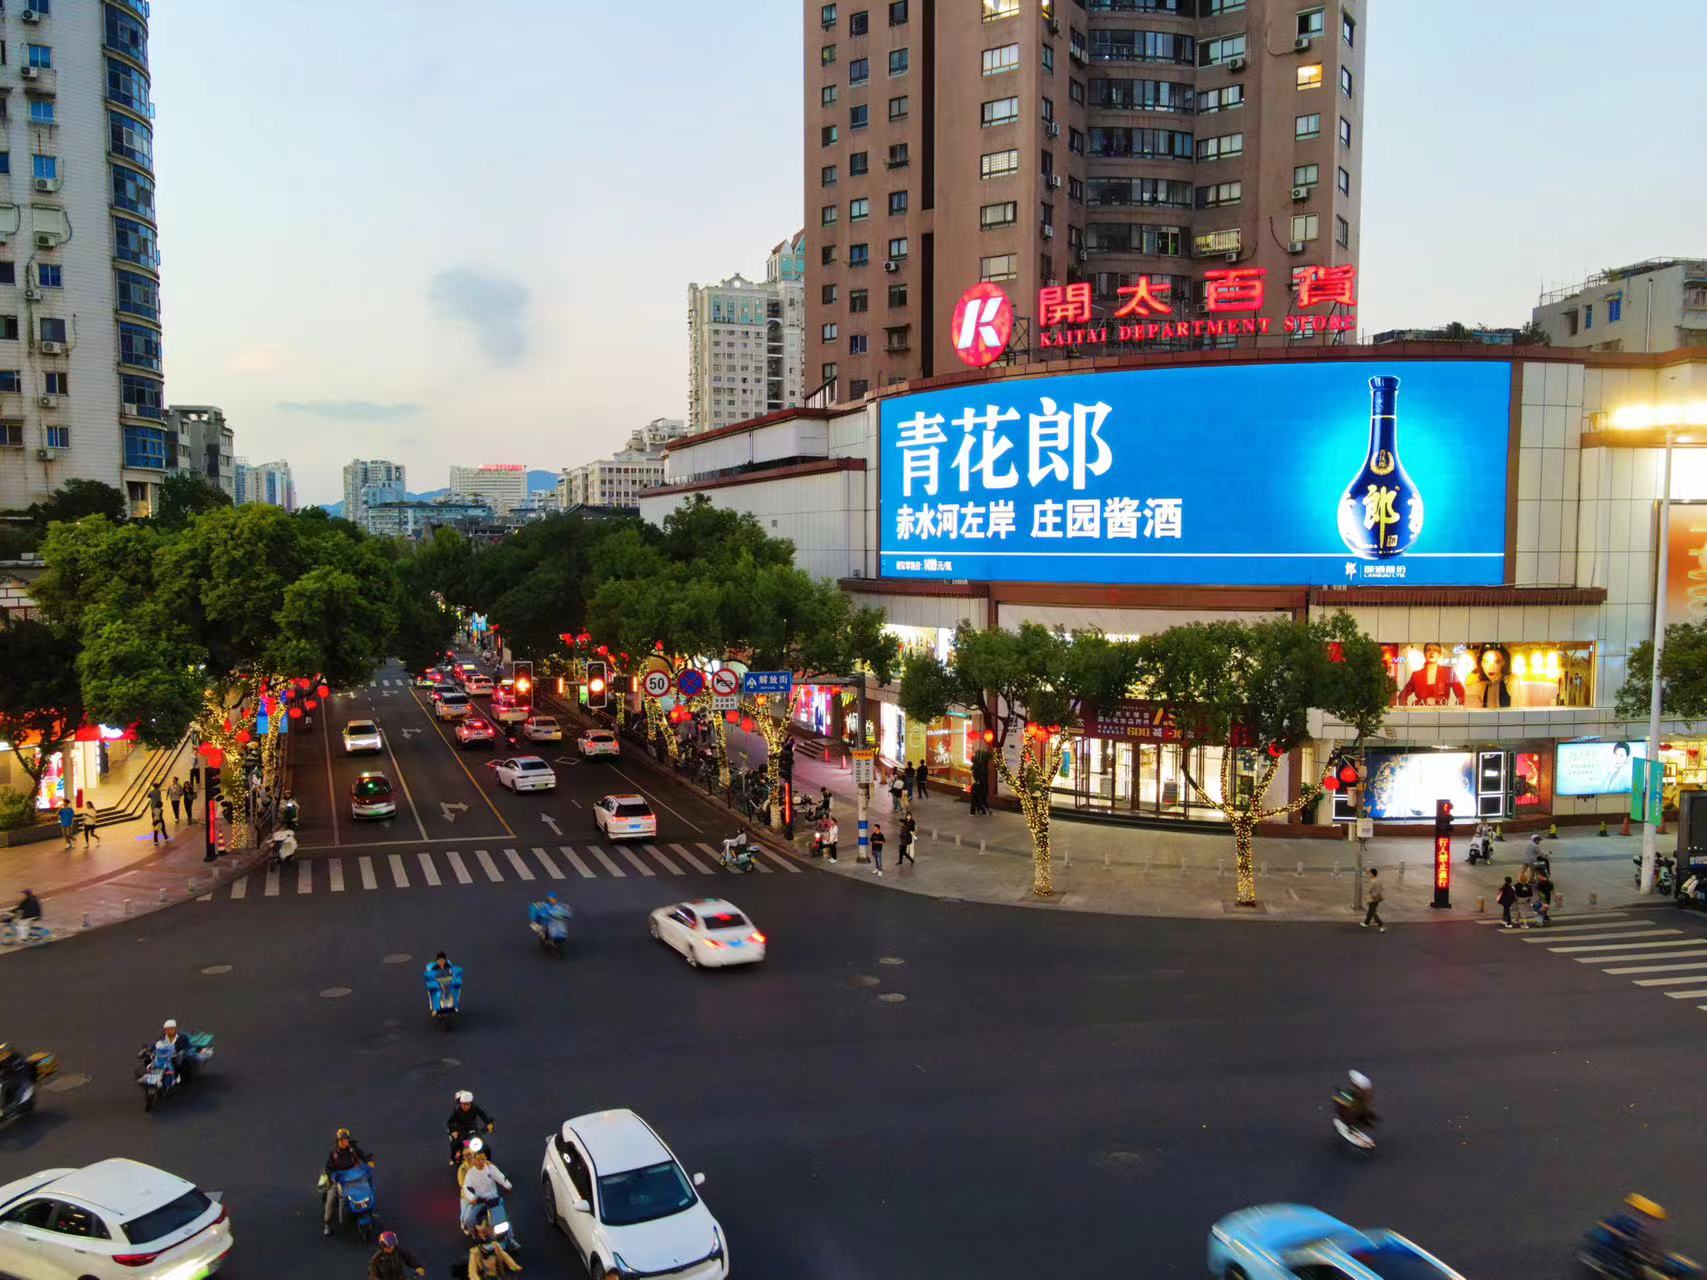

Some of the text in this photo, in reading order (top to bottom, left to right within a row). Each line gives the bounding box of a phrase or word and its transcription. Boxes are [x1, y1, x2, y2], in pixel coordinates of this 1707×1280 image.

[1039, 264, 1357, 327] 開太百貨
[957, 297, 1003, 349] K
[1040, 313, 1357, 347] KAITAI DEPARTMENT STORE
[895, 396, 1113, 497] 青花郎
[896, 496, 1183, 540] 赤水河左岸 庄园酱酒
[649, 678, 665, 691] 50
[758, 675, 789, 685] 解放街
